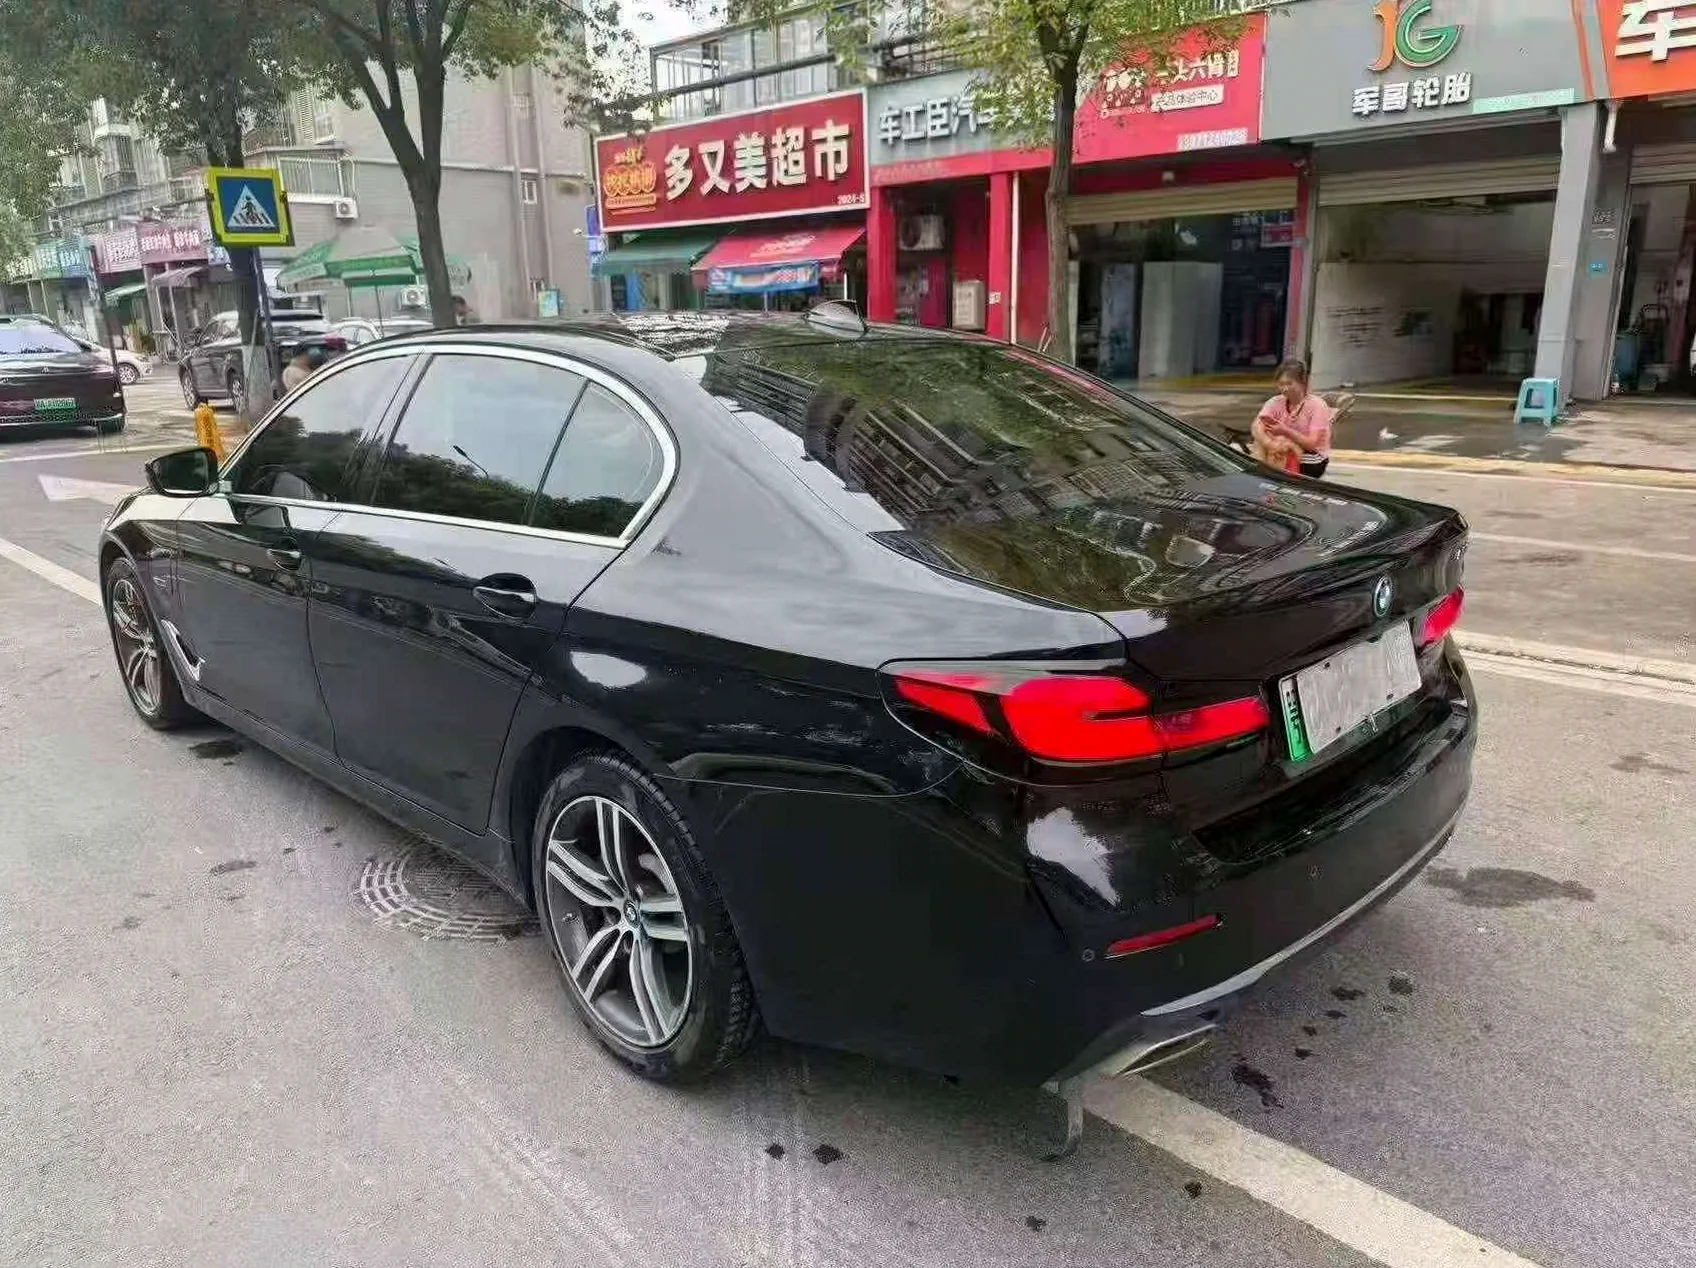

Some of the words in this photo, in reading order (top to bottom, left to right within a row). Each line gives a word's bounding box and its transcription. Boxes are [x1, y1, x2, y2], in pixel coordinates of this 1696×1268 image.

[1352, 72, 1473, 115] 军哥轮胎
[664, 119, 850, 201] 多又美超市
